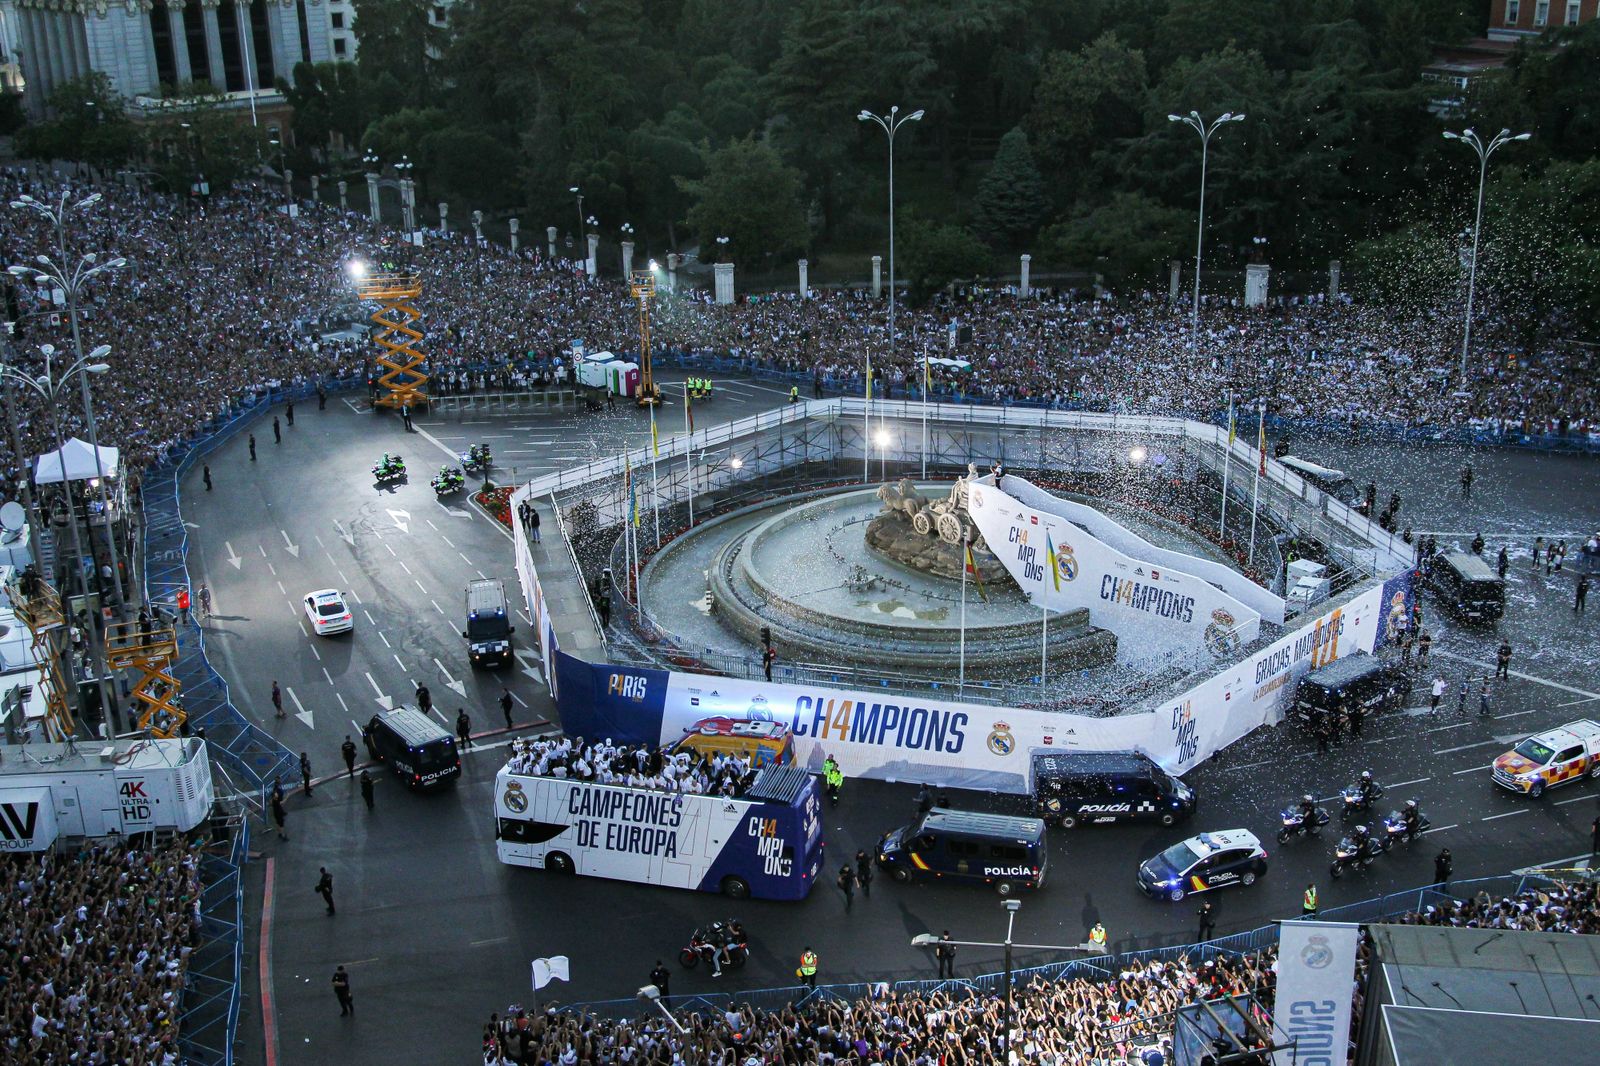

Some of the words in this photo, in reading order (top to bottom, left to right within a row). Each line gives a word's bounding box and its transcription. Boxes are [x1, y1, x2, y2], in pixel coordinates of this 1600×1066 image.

[1017, 545, 1036, 563] MPI
[1024, 563, 1043, 581] ONS
[1175, 718, 1196, 747] MPI
[1178, 735, 1199, 764] ONS
[119, 781, 148, 798] 4K
[121, 798, 149, 806] ULTRA
[568, 786, 683, 828] CAMPEONES
[123, 806, 151, 821] HD
[577, 819, 601, 849] DE
[605, 822, 677, 859] EUROPA
[757, 837, 785, 858] MPI
[984, 865, 1032, 876] POLICÍA
